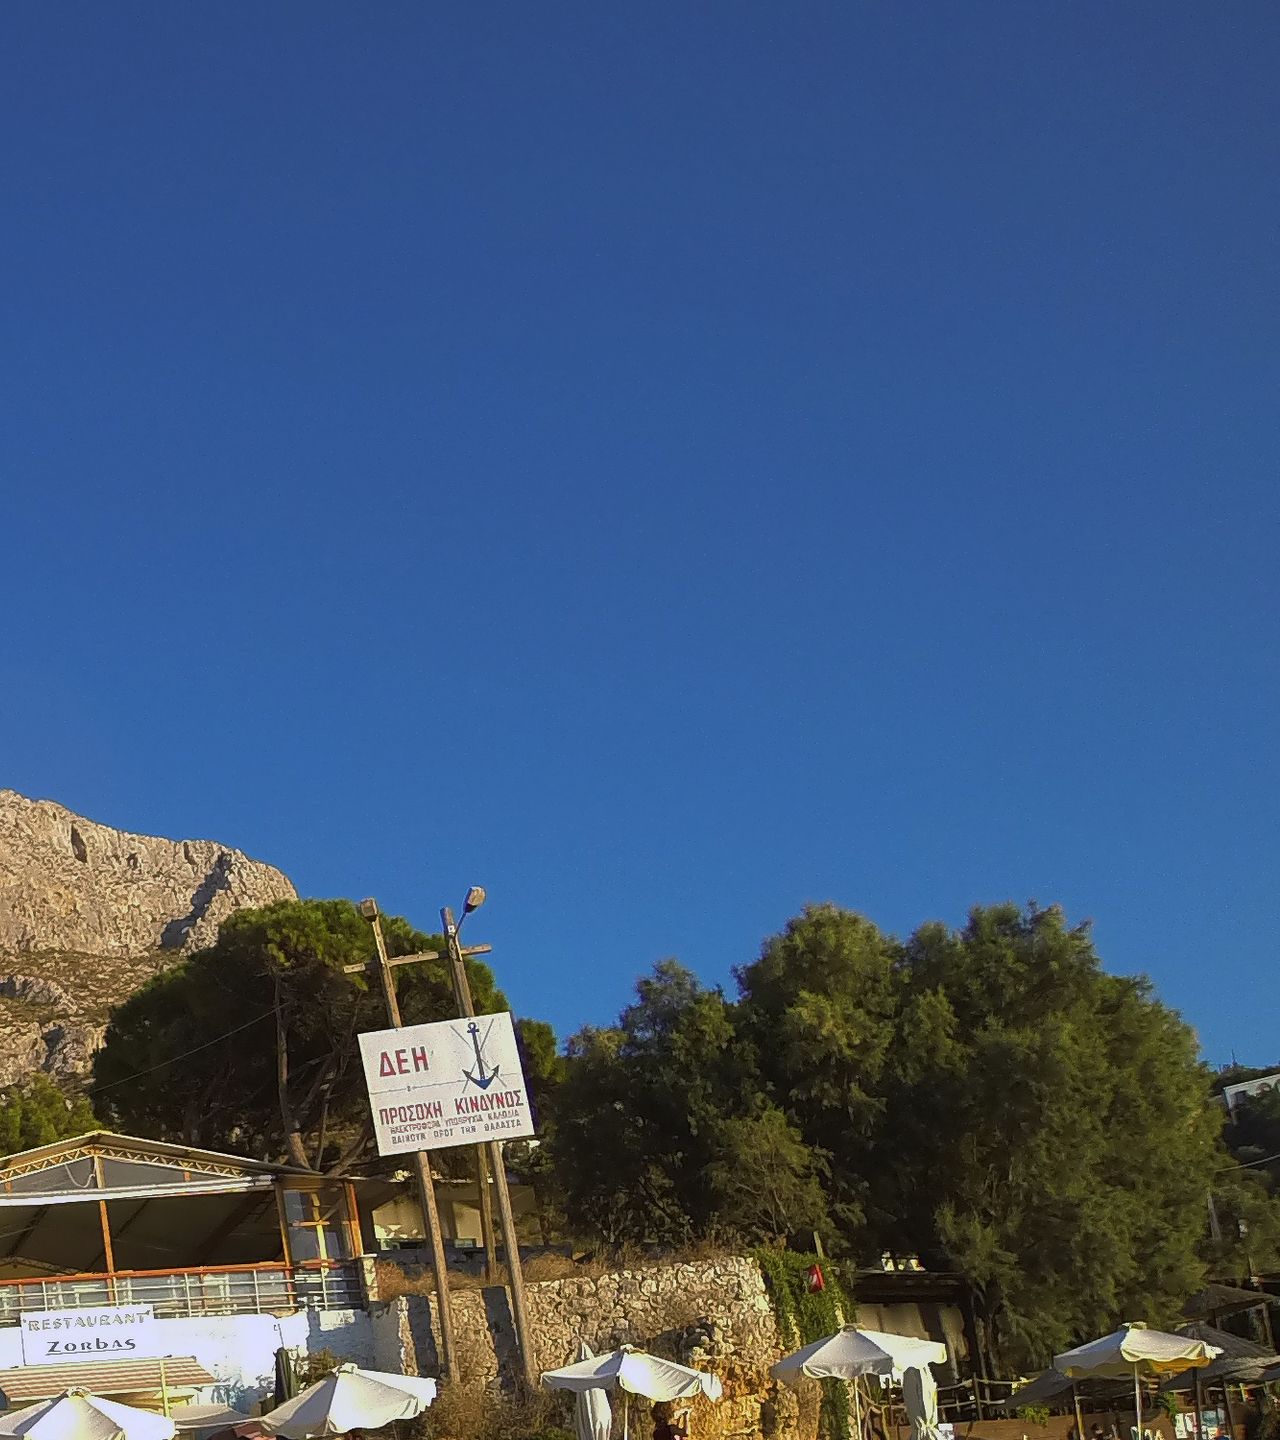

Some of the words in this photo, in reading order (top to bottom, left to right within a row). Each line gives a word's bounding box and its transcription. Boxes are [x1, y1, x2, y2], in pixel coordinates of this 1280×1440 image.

[379, 1046, 429, 1077] ΔΕΗ
[379, 1101, 443, 1125] ΠΡΟΣΟΧΗ
[455, 1090, 524, 1115] ΚΙΝΔΥΝΟΣ
